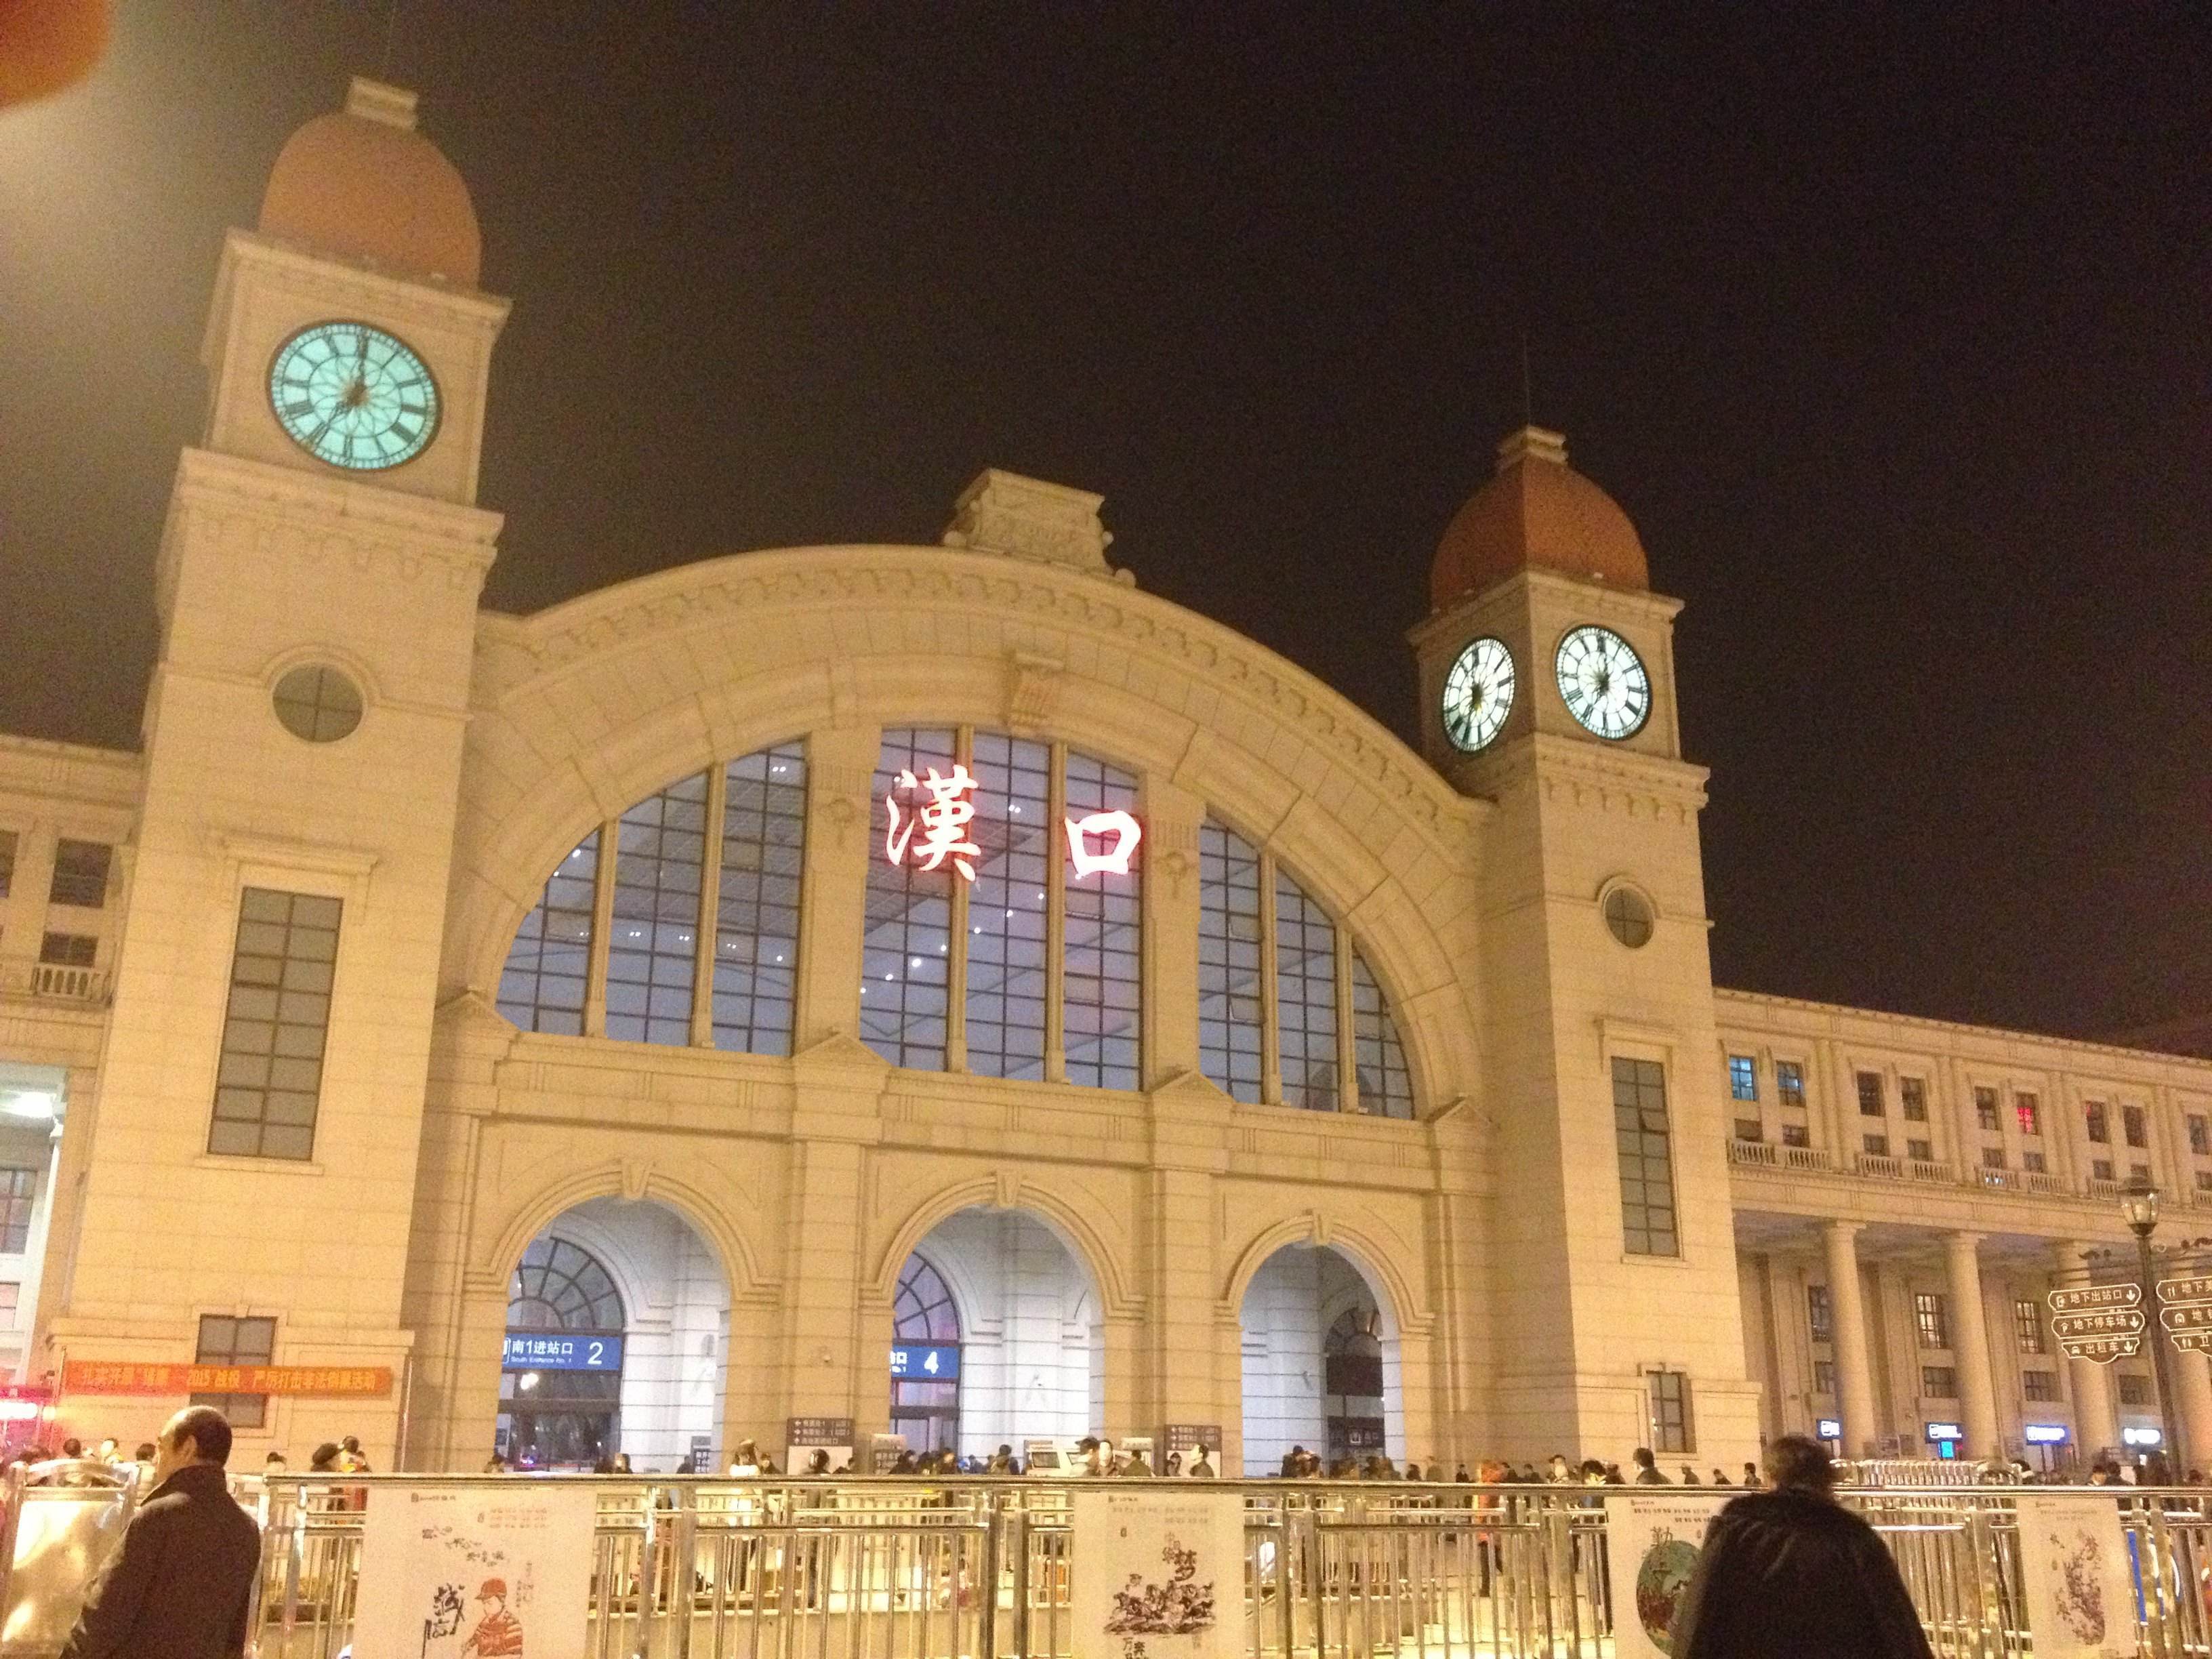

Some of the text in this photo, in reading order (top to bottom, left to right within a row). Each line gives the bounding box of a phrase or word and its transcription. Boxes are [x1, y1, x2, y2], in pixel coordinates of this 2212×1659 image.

[886, 764, 1142, 881] 漢口
[2070, 1289, 2123, 1304] 地下出站口
[2074, 1315, 2127, 1330] 地下停车场
[512, 1339, 604, 1365] 南1进站口 2
[2085, 1341, 2120, 1354] 出租车
[924, 1351, 939, 1374] 4
